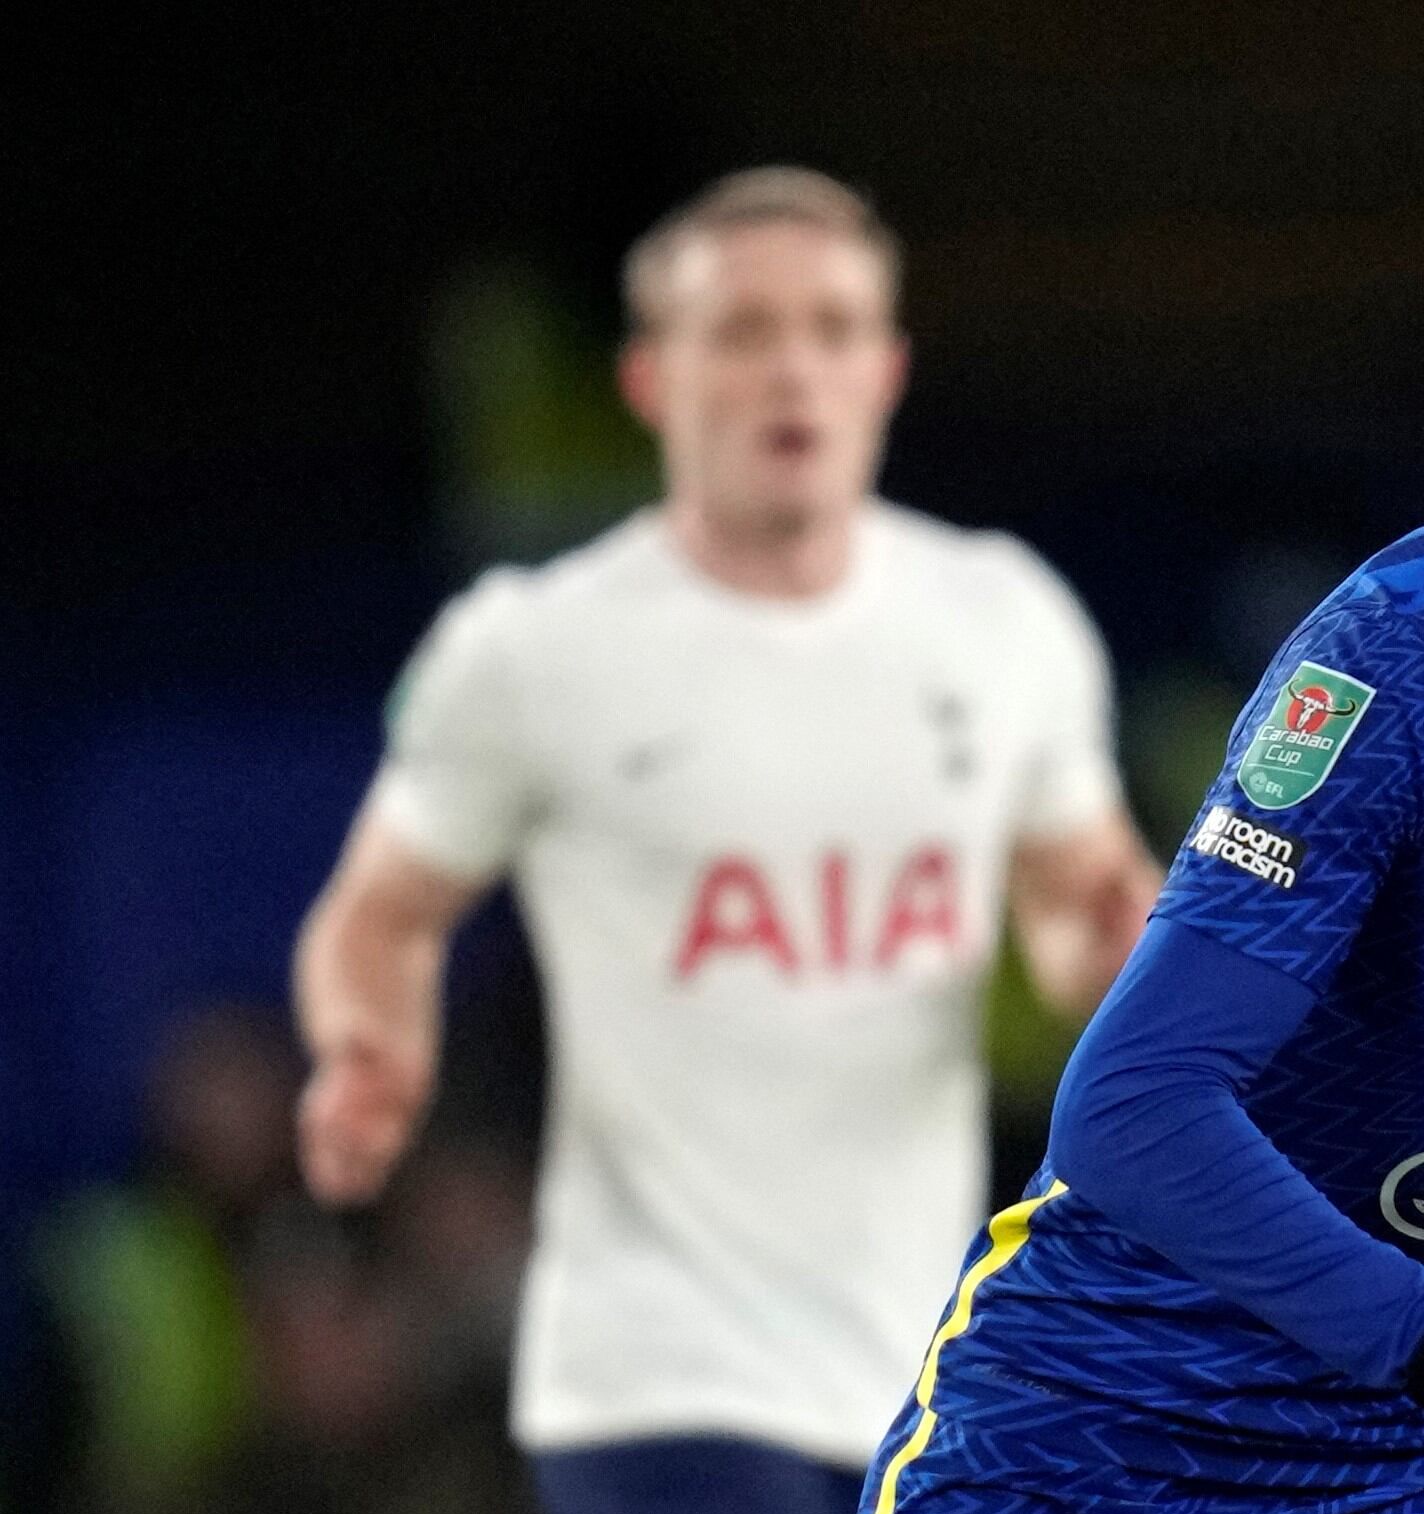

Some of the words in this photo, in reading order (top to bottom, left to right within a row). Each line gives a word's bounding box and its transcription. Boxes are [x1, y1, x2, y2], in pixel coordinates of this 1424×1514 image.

[1258, 725, 1334, 750] Carabao
[1264, 744, 1302, 766] Cup
[1265, 781, 1284, 798] EFL
[1225, 817, 1293, 862] room
[1213, 837, 1296, 888] racism
[670, 845, 968, 982] AIA
